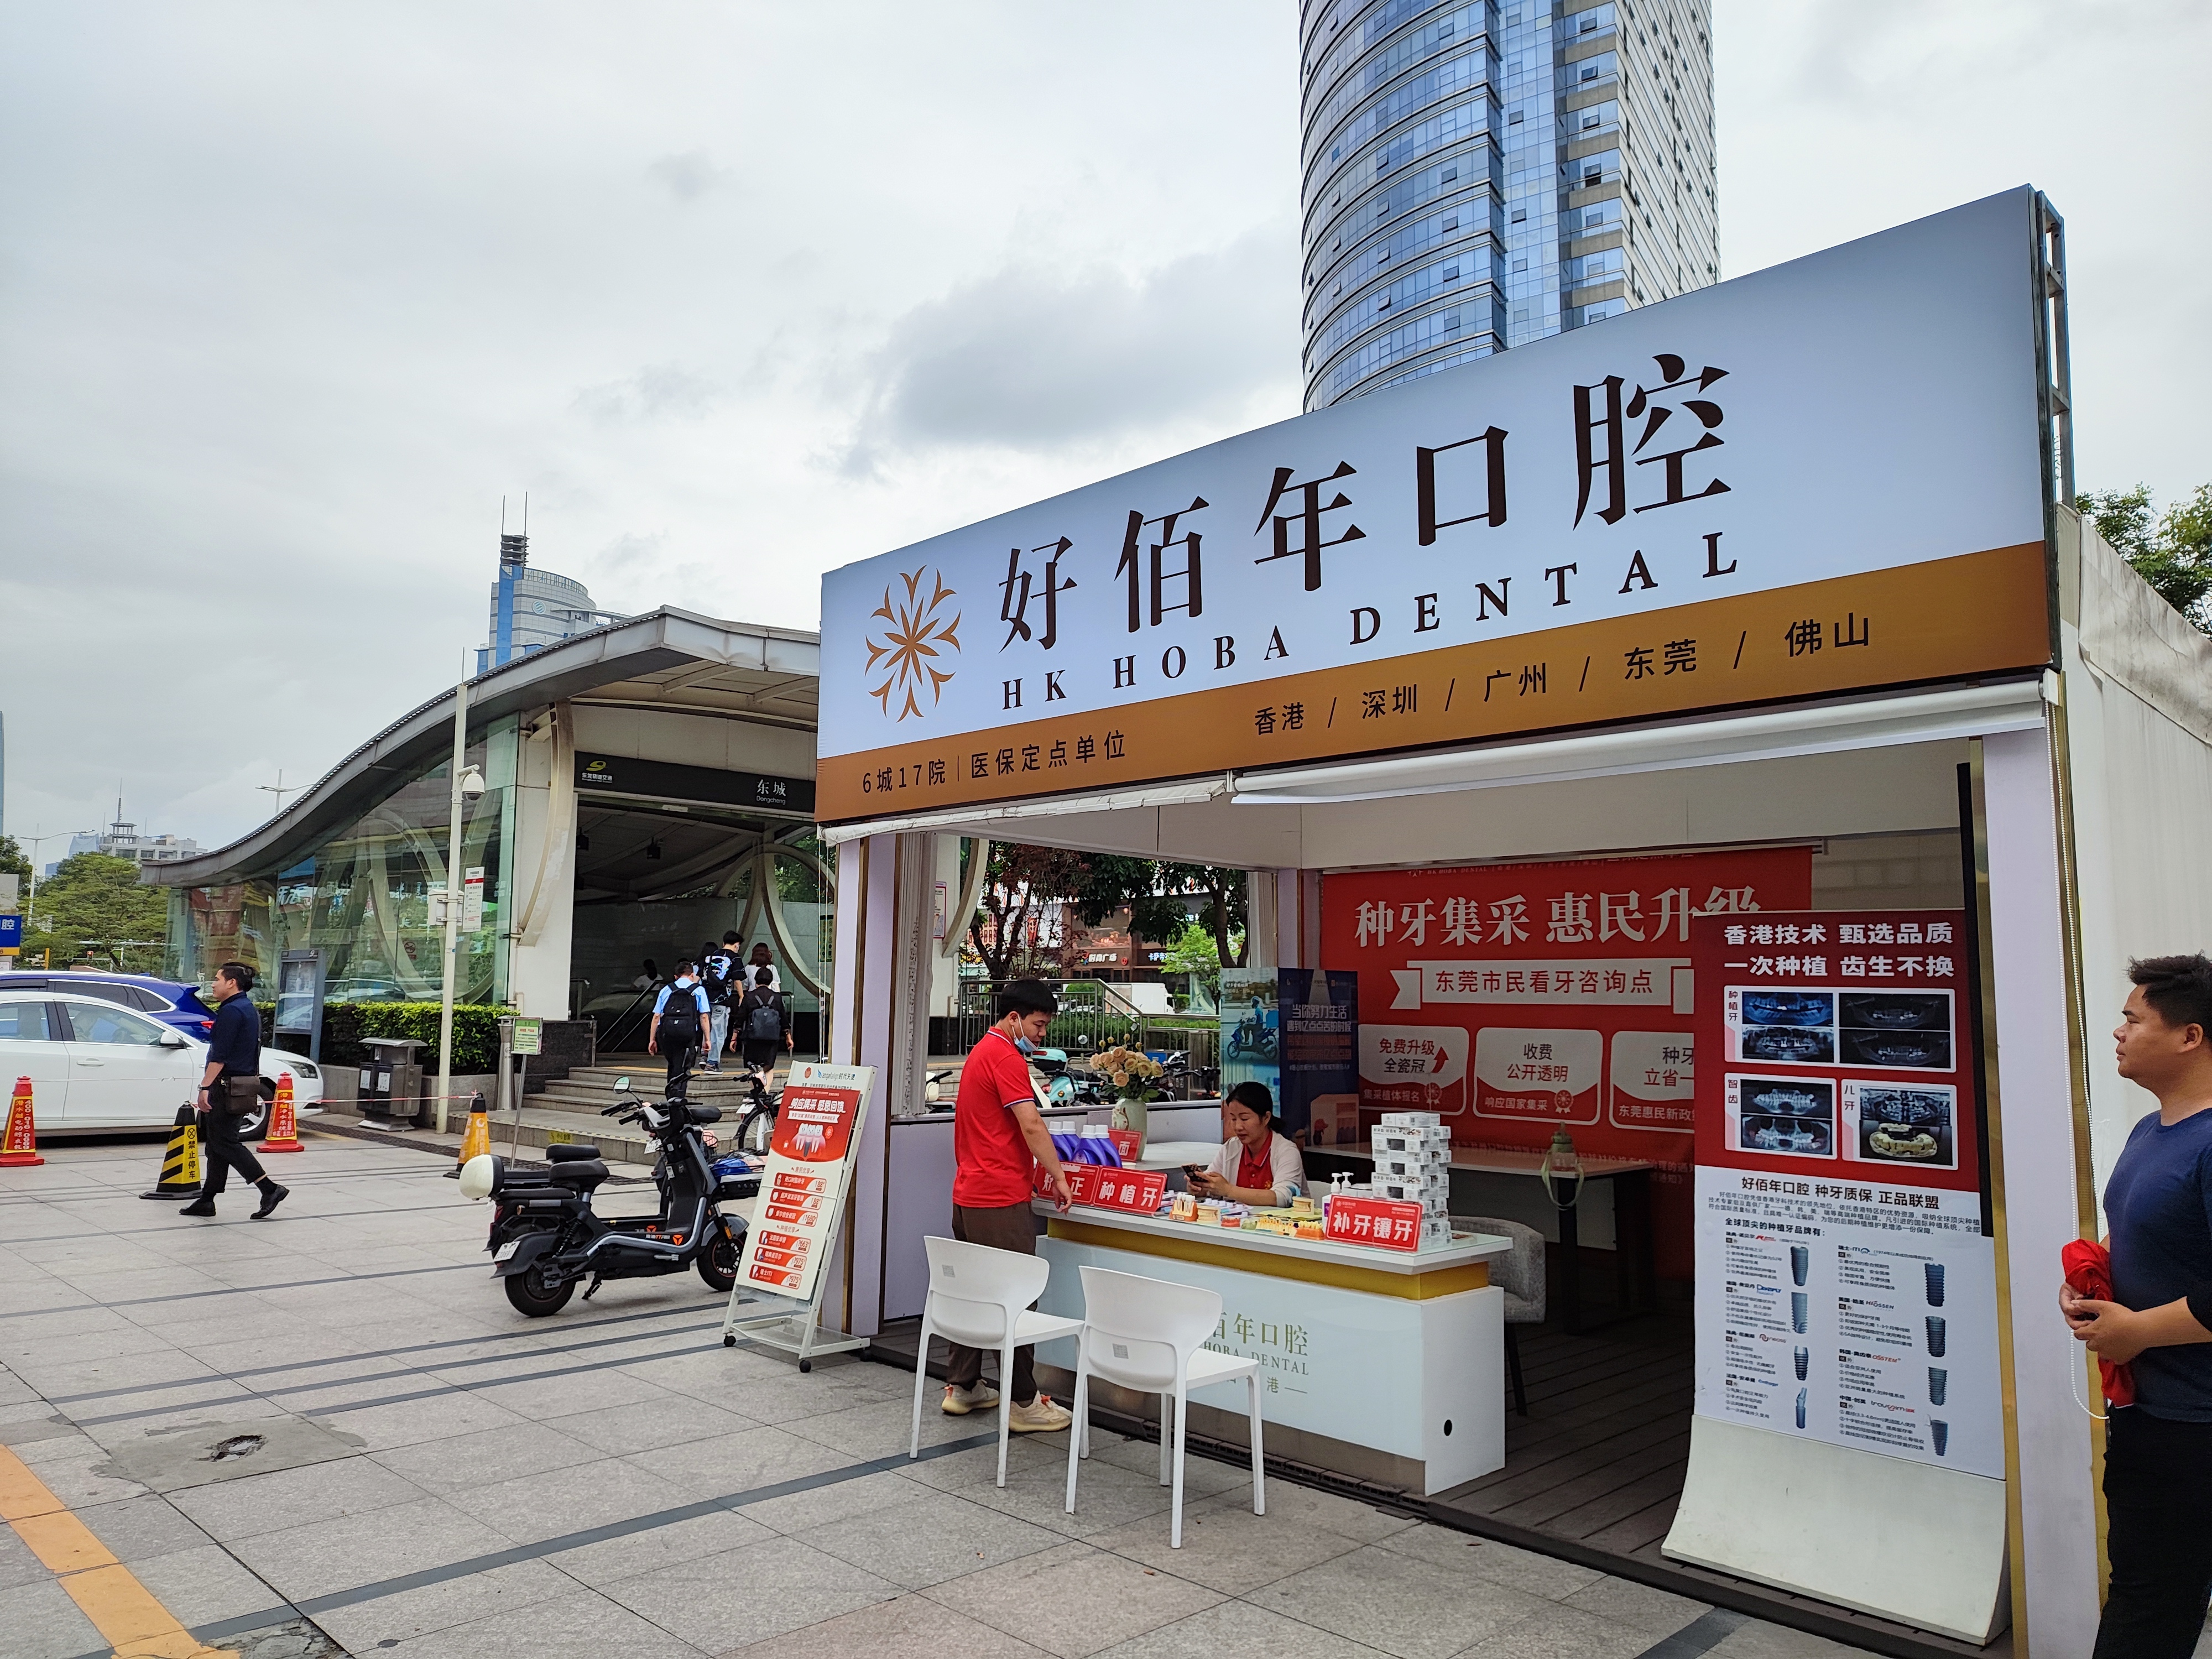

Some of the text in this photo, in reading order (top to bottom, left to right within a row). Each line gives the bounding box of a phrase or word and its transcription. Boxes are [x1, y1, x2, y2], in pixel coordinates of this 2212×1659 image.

[998, 353, 1731, 653] 好佰年口腔
[1002, 533, 1737, 711] HK HOBA DENTAL
[1254, 702, 1305, 735] 香港
[1361, 684, 1418, 721] 深圳
[1484, 662, 1546, 703] 广州
[1623, 639, 1698, 682] 东莞
[1785, 612, 1870, 658] 佛山
[862, 729, 1125, 794] 6城17院 医保定点单位
[757, 779, 786, 796] 东城
[756, 795, 786, 805] Dongcheng
[1355, 894, 1531, 948] 种牙集采
[1724, 922, 1954, 945] 香港技术 甄选品质
[1724, 955, 1955, 977] 一次种植 齿生不换
[1435, 968, 1653, 994] 东莞市民看牙咨询点
[1292, 1004, 1347, 1019] 当你努力生活
[1728, 990, 1739, 1022] 种植牙
[1379, 1037, 1434, 1056] 免费升级
[1523, 1043, 1553, 1061] 收费
[1384, 1057, 1425, 1074] 全瓷冠
[1507, 1064, 1569, 1083] 公开透明
[1363, 1088, 1420, 1103] 集采植体报名
[1728, 1078, 1739, 1104] 智齿
[1844, 1084, 1856, 1111] 儿牙
[789, 1097, 846, 1113] 响应集采 感恩回馈
[1484, 1096, 1548, 1112] 响应国家集采
[1098, 1181, 1158, 1207] 种植牙
[1741, 1176, 1940, 1209] 好佰年口腔 种牙质保 正品联盟
[1333, 1211, 1413, 1242] 补牙镶牙
[1251, 1351, 1310, 1375] DENTAL
